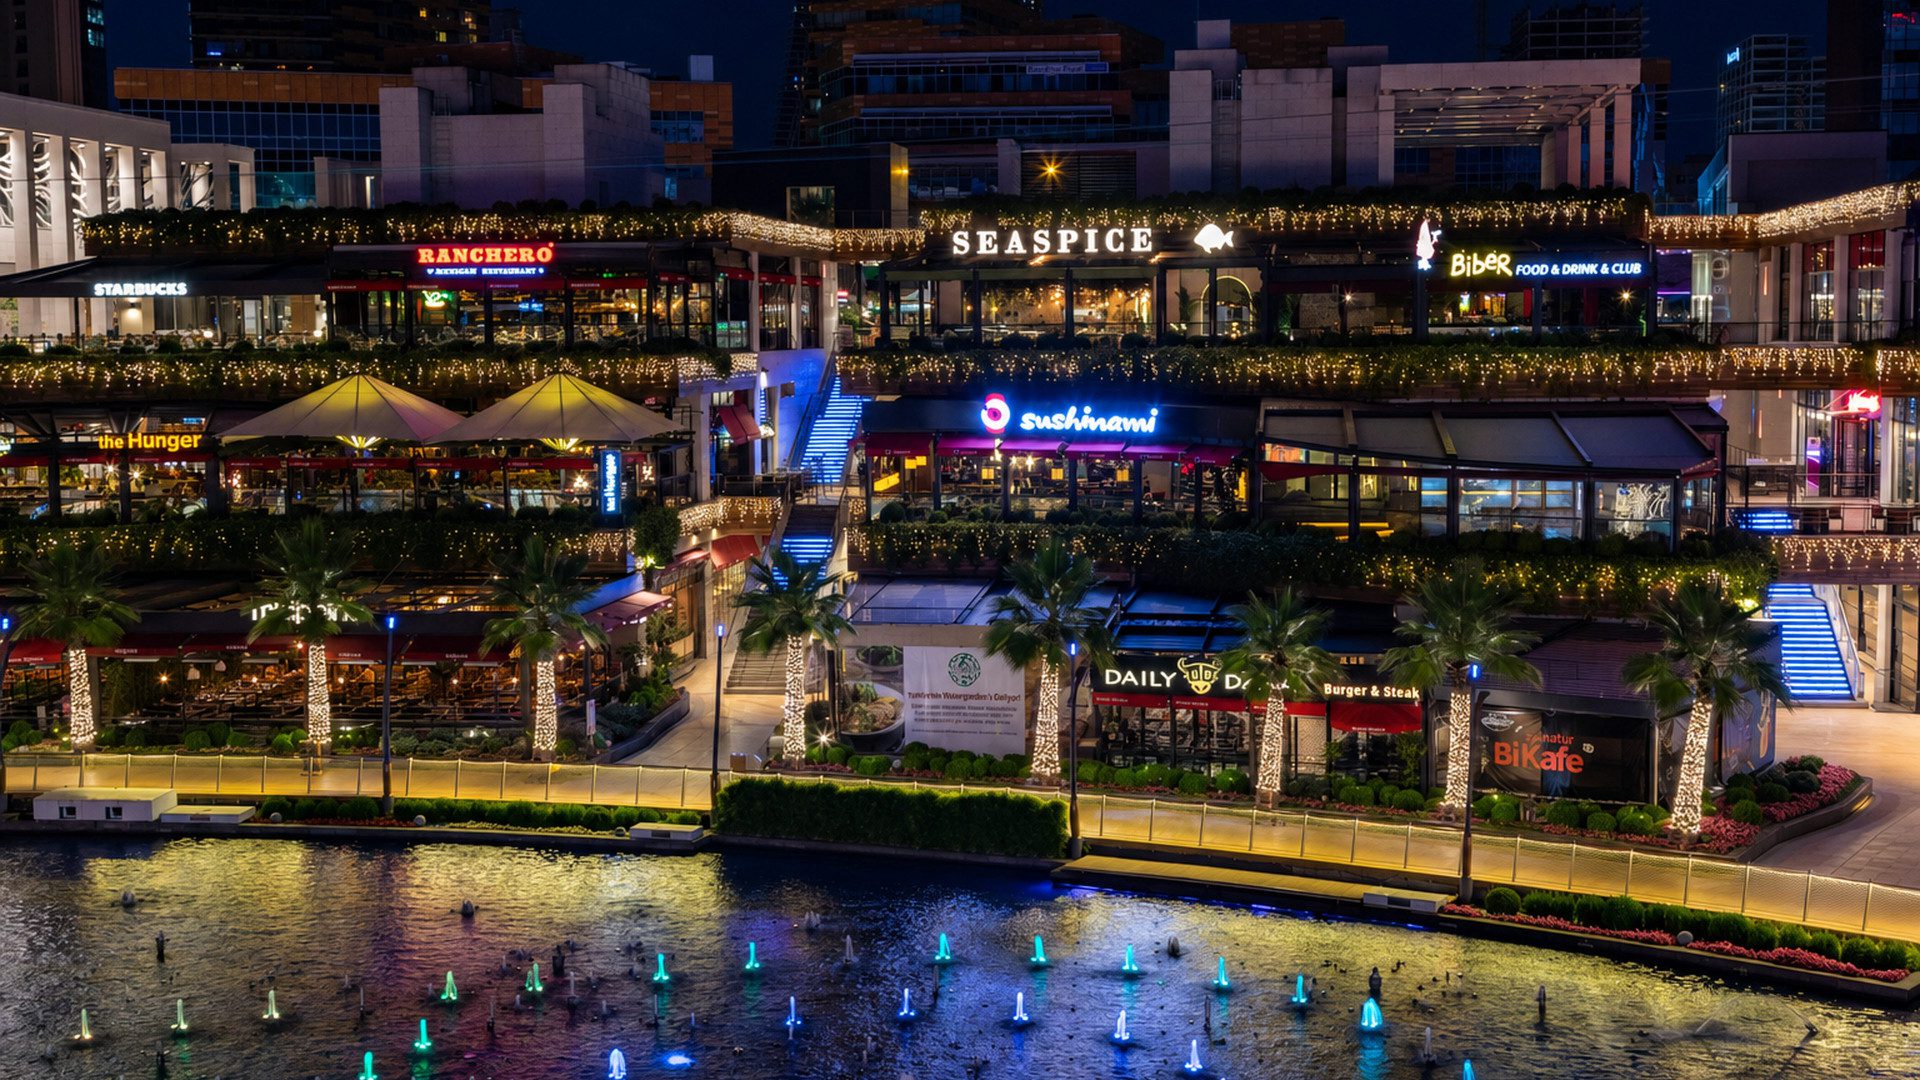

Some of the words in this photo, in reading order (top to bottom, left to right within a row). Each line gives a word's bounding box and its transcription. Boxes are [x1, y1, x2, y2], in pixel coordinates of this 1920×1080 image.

[953, 228, 1153, 255] SEASPICE
[418, 247, 552, 263] RANCHERO
[1515, 264, 1548, 275] FOOD
[1551, 264, 1559, 275] &
[1562, 264, 1597, 275] DRINK
[1600, 263, 1609, 274] &
[1612, 262, 1642, 274] CLUB
[94, 282, 187, 296] STARBUCKS
[1020, 406, 1158, 432] sushinami
[98, 434, 124, 449] the
[128, 432, 202, 452] Hunger
[1105, 669, 1177, 687] DAILY
[1324, 683, 1367, 698] Burger
[1370, 685, 1380, 697] &
[1383, 686, 1420, 699] Steak
[1494, 741, 1584, 774] BiKafe
